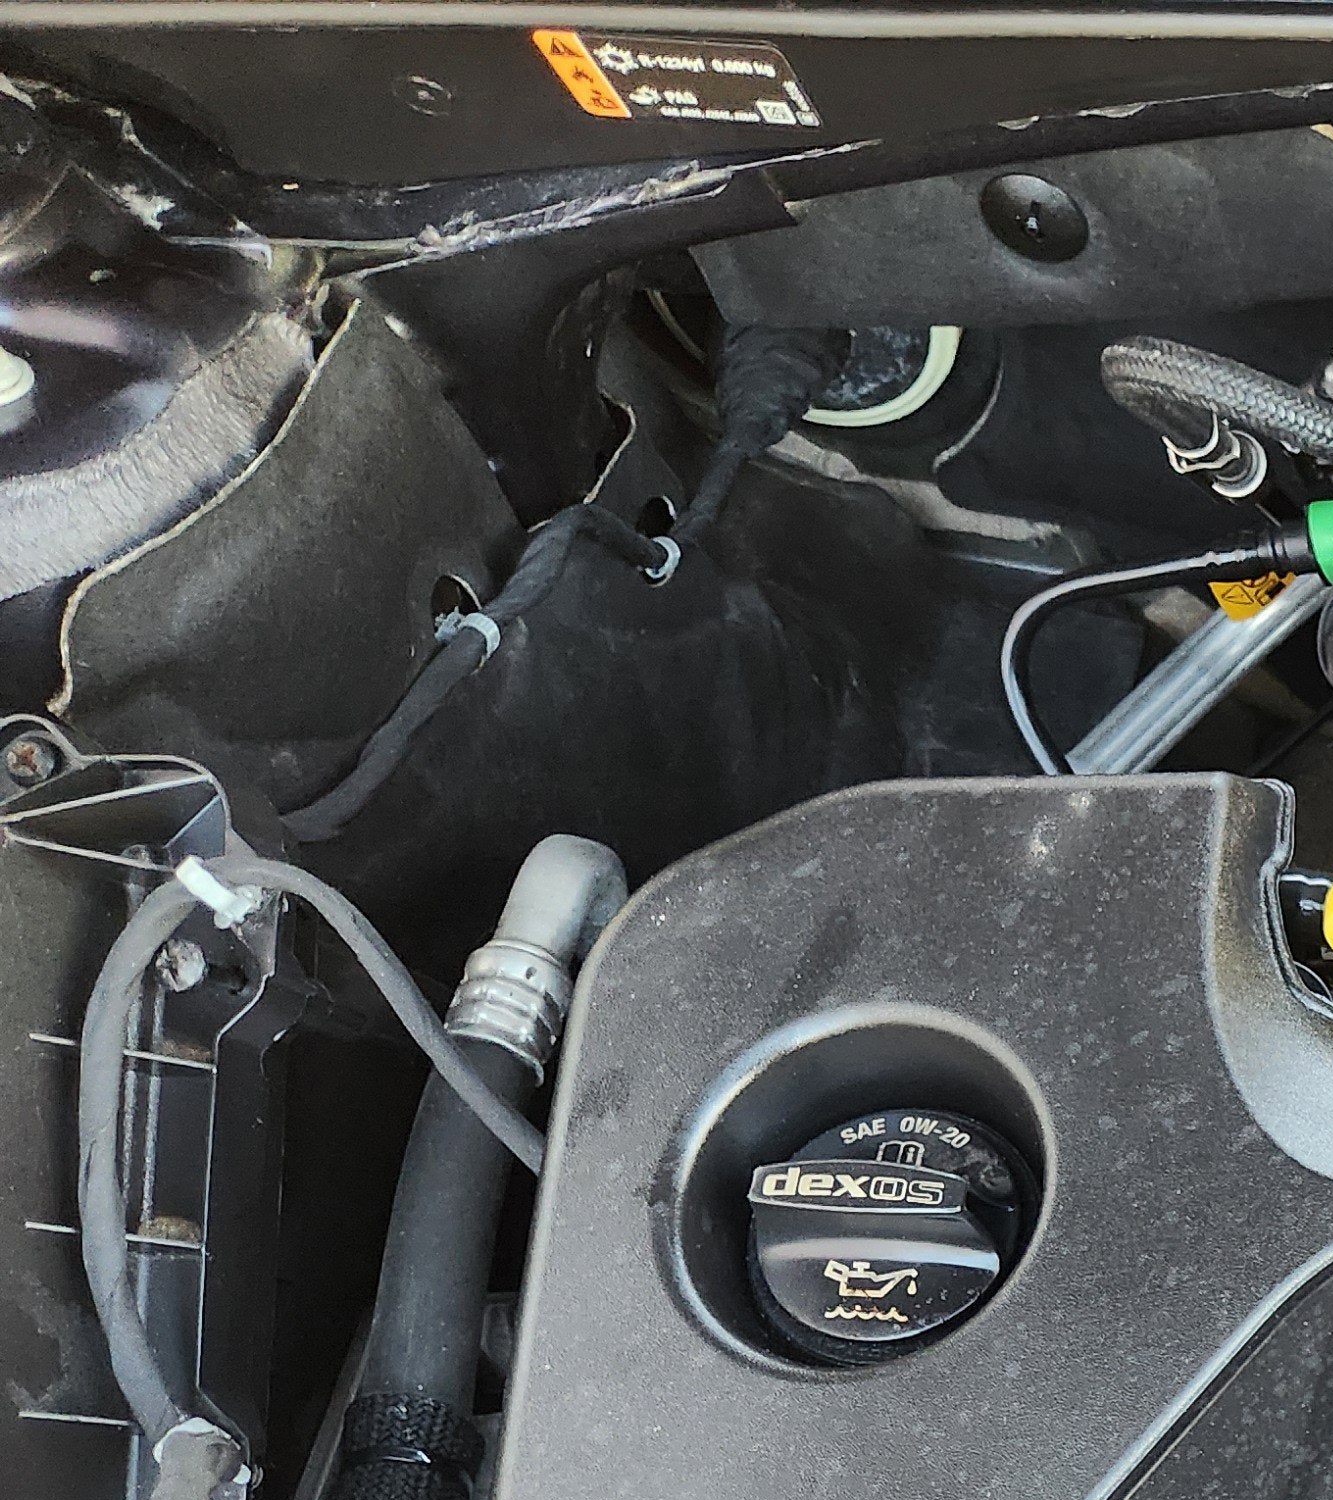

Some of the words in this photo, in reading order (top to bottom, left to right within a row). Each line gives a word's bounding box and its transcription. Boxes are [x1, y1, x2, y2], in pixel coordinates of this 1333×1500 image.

[840, 1118, 886, 1144] SAE
[900, 1116, 971, 1148] 0W-20
[762, 1167, 945, 1205] dexos
